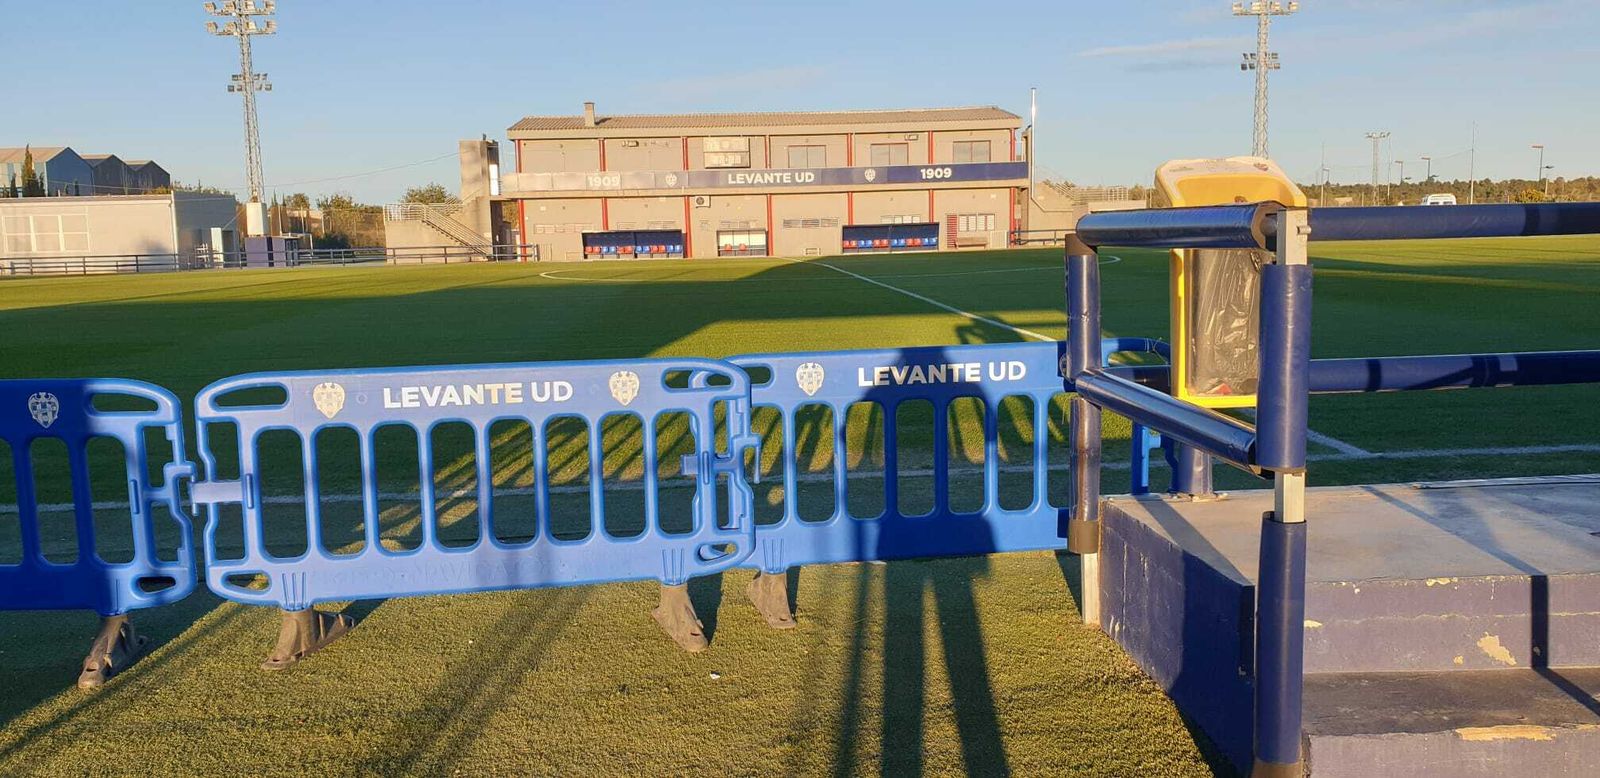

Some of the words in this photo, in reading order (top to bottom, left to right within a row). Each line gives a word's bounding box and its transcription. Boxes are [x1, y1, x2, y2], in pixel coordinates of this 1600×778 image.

[728, 172, 791, 185] LEVANTE
[795, 172, 815, 184] UD
[920, 167, 952, 179] 1909
[588, 174, 620, 187] 1909
[857, 362, 982, 387] LEVANTE
[988, 360, 1026, 382] UD
[383, 381, 523, 409] LEVANTE
[530, 380, 574, 403] UD
